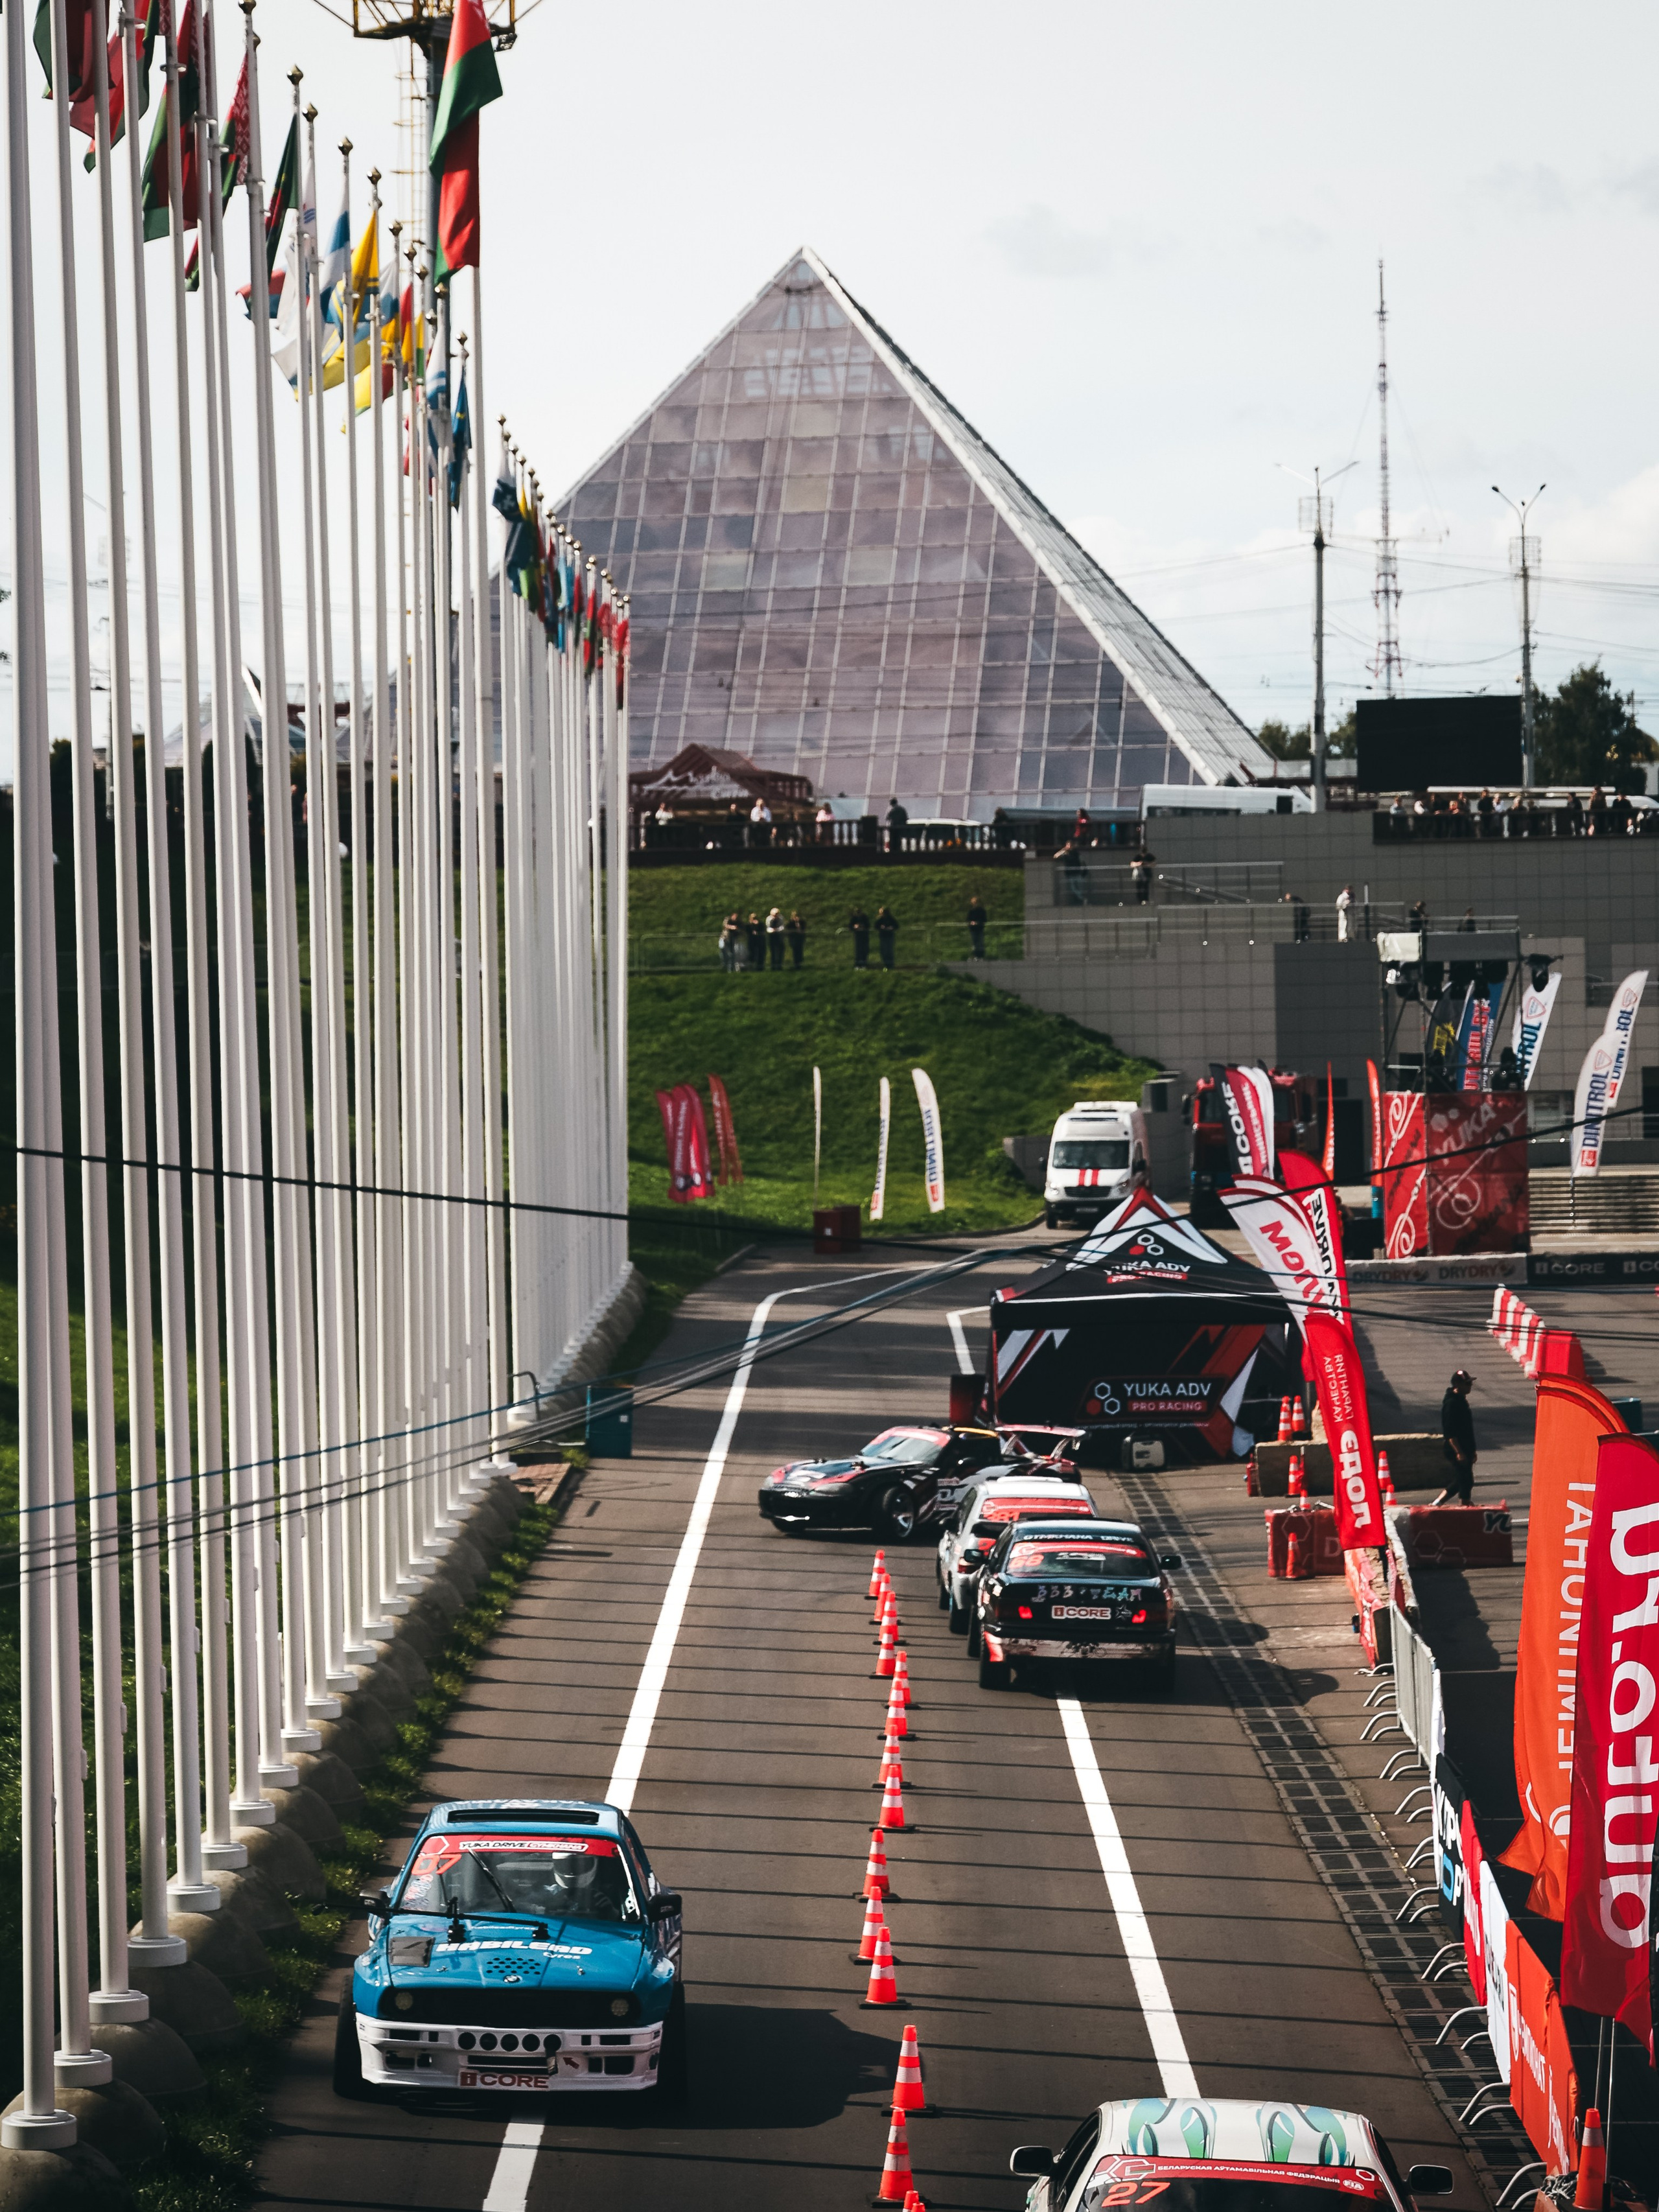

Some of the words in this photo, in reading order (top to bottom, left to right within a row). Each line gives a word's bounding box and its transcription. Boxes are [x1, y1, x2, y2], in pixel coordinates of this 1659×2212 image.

[1154, 1261, 1191, 1273] ADV
[1439, 1265, 1497, 1279] DRYDRY
[1551, 1261, 1606, 1275] CORE
[1123, 1382, 1172, 1397] YUKA
[1176, 1382, 1212, 1396] ADV
[1131, 1402, 1155, 1411] PRO
[1159, 1401, 1202, 1411] RACING
[1008, 1554, 1045, 1569] 68
[1066, 1607, 1111, 1618] CORE
[529, 1842, 583, 1850] GYMKHANA
[412, 1853, 462, 1875] 07
[435, 1940, 593, 1955] HABILEAD
[542, 1951, 581, 1960] tyres
[480, 2073, 550, 2089] CORE
[1214, 2165, 1285, 2176] АЎТАМАБІЛЬНАЯ
[1286, 2171, 1341, 2183] ФЕДЭРАЦЫЯ
[1343, 2180, 1363, 2190] FIA
[1101, 2180, 1171, 2208] 27
